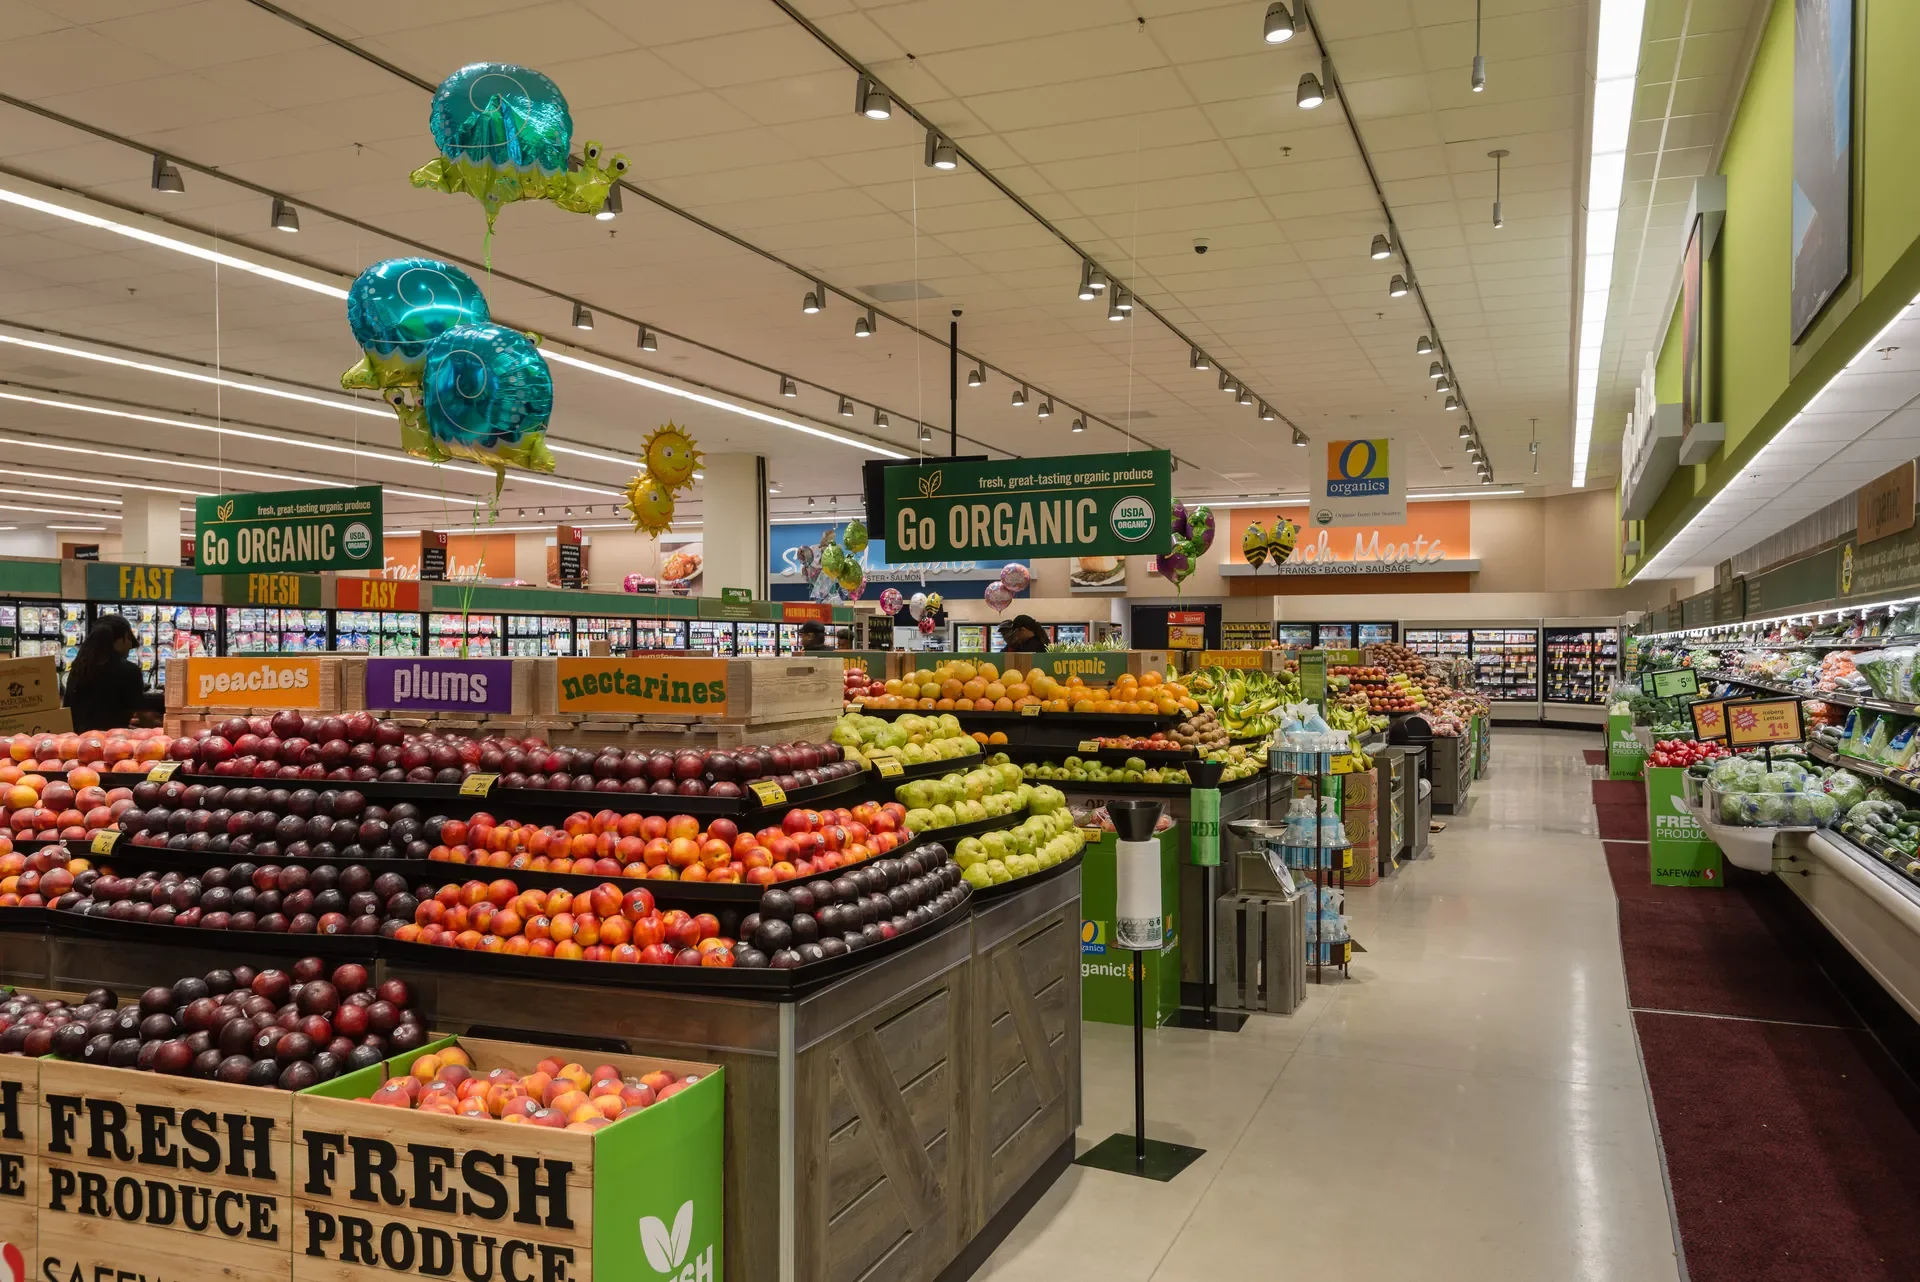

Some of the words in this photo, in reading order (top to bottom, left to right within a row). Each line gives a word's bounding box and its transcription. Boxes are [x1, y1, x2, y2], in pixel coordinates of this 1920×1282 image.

[1339, 439, 1377, 480] O
[979, 475, 1007, 489] fresh,
[1008, 472, 1072, 489] great-tasting
[1074, 469, 1110, 485] organic
[1113, 467, 1154, 482] produce
[1330, 480, 1385, 495] organics
[258, 504, 277, 516] fresh,
[277, 501, 319, 516] great-tasting
[319, 500, 343, 513] organic
[344, 499, 371, 512] produce
[1121, 507, 1145, 518] USDA
[1335, 511, 1355, 519] Organic
[1866, 486, 1900, 534] Organic
[898, 507, 936, 551] Go
[949, 498, 1098, 549] ORGANIC
[1117, 519, 1148, 530] ORGANIC
[350, 531, 366, 540] USDA
[438, 534, 447, 544] 13
[574, 529, 581, 539] 14
[203, 529, 229, 566] Go
[237, 524, 335, 564] ORGANIC
[347, 541, 368, 550] ORGANIC
[1353, 531, 1446, 566] Meats
[1280, 566, 1317, 574] FRANKS
[1324, 565, 1357, 574] BACON
[1366, 564, 1411, 573] SAUSAGE
[120, 565, 175, 600] FAST
[866, 574, 886, 582] STER
[890, 574, 921, 582] SALMON
[249, 573, 301, 606] FRESH
[361, 581, 398, 609] EASY
[785, 607, 807, 618] PREMIUM
[1201, 652, 1261, 667] Bananas
[1328, 652, 1349, 662] ala
[1053, 657, 1106, 677] organic
[199, 665, 309, 698] peaches
[394, 663, 488, 703] plums
[562, 667, 727, 704] nectarines
[1656, 815, 1701, 828] FRES
[1656, 828, 1708, 839] PRODUC
[1656, 868, 1701, 878] SAFEWAY
[1082, 944, 1104, 952] ganics
[1082, 962, 1126, 977] ganic!
[46, 1094, 277, 1181] FRESH
[302, 1130, 575, 1230] FRESH
[48, 1168, 279, 1242] PRODUCE
[304, 1209, 577, 1282] PRODUCE
